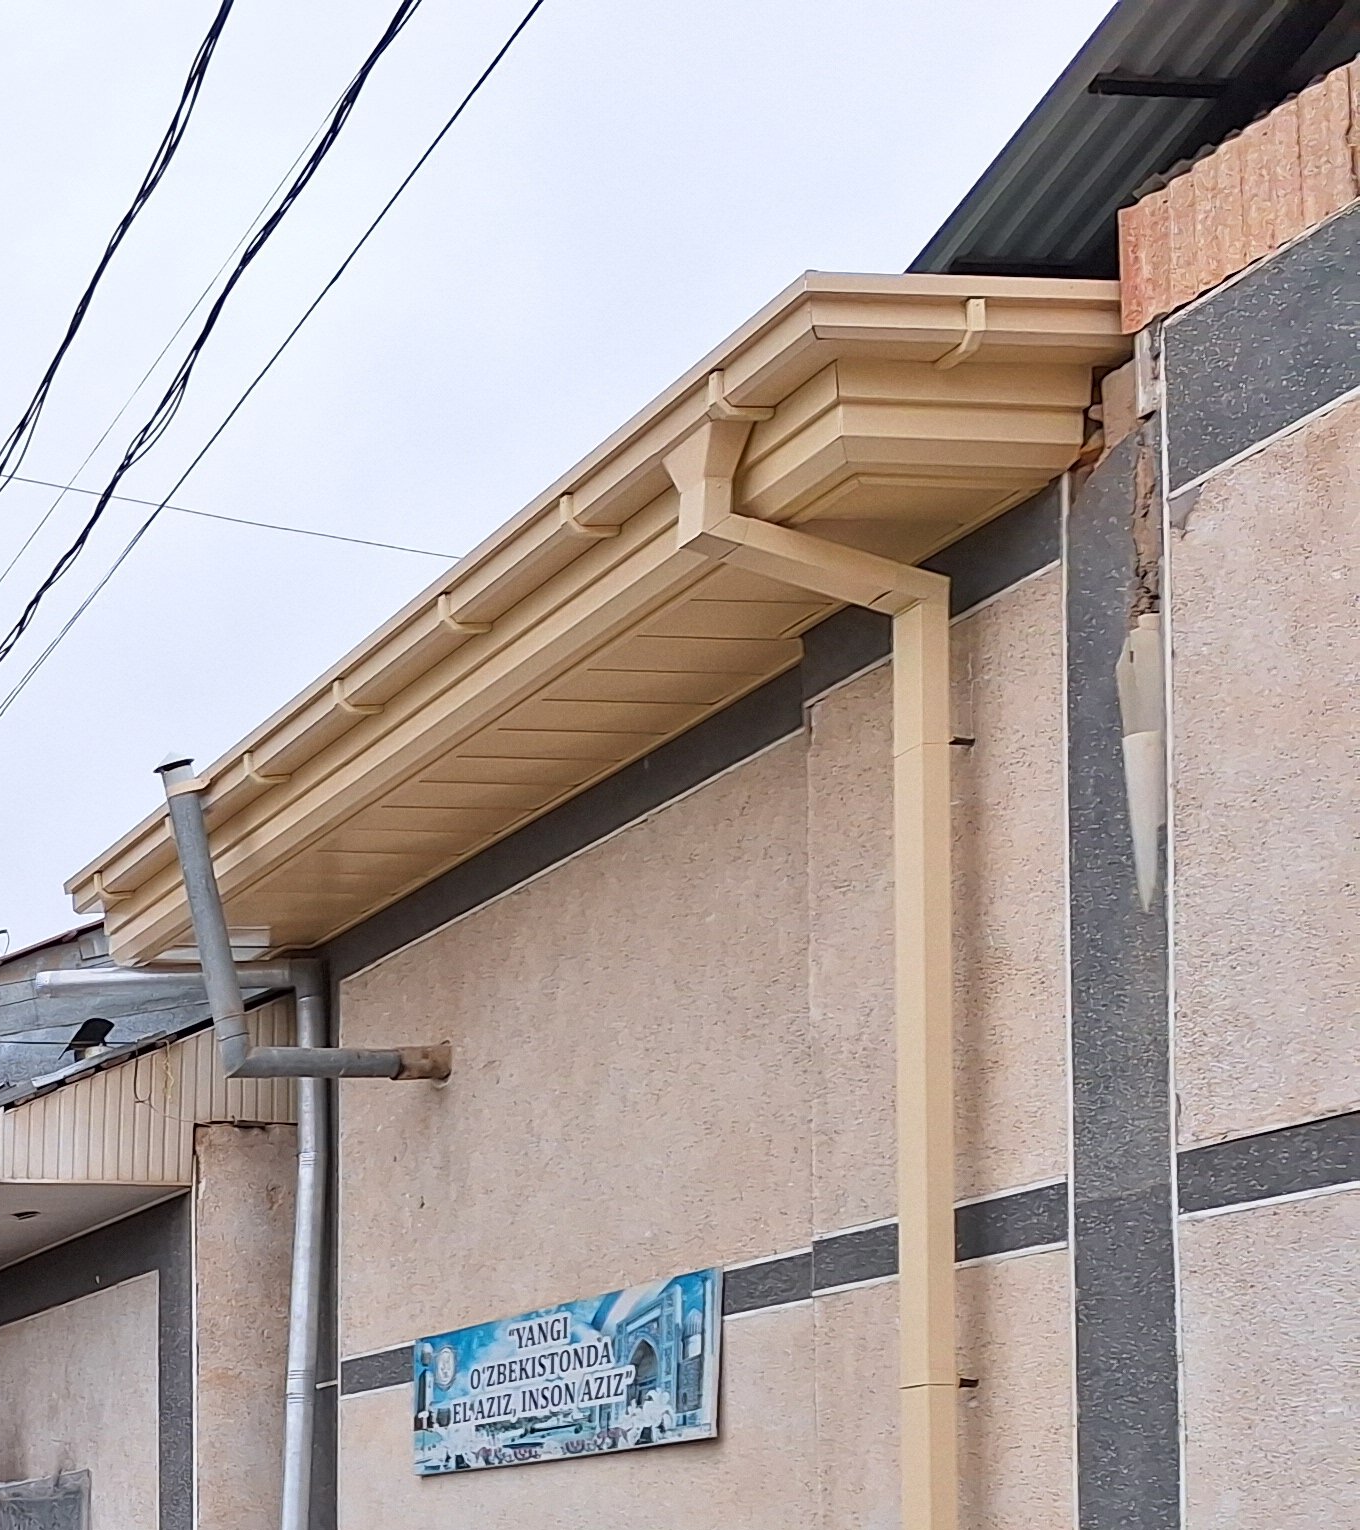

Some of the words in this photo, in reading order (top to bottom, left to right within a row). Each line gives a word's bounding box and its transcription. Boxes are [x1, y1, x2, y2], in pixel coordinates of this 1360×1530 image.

[508, 1316, 568, 1349] “YANGI
[474, 1393, 516, 1421] AZIZ,
[521, 1381, 576, 1413] INSON
[579, 1370, 633, 1403] AZIZ”
